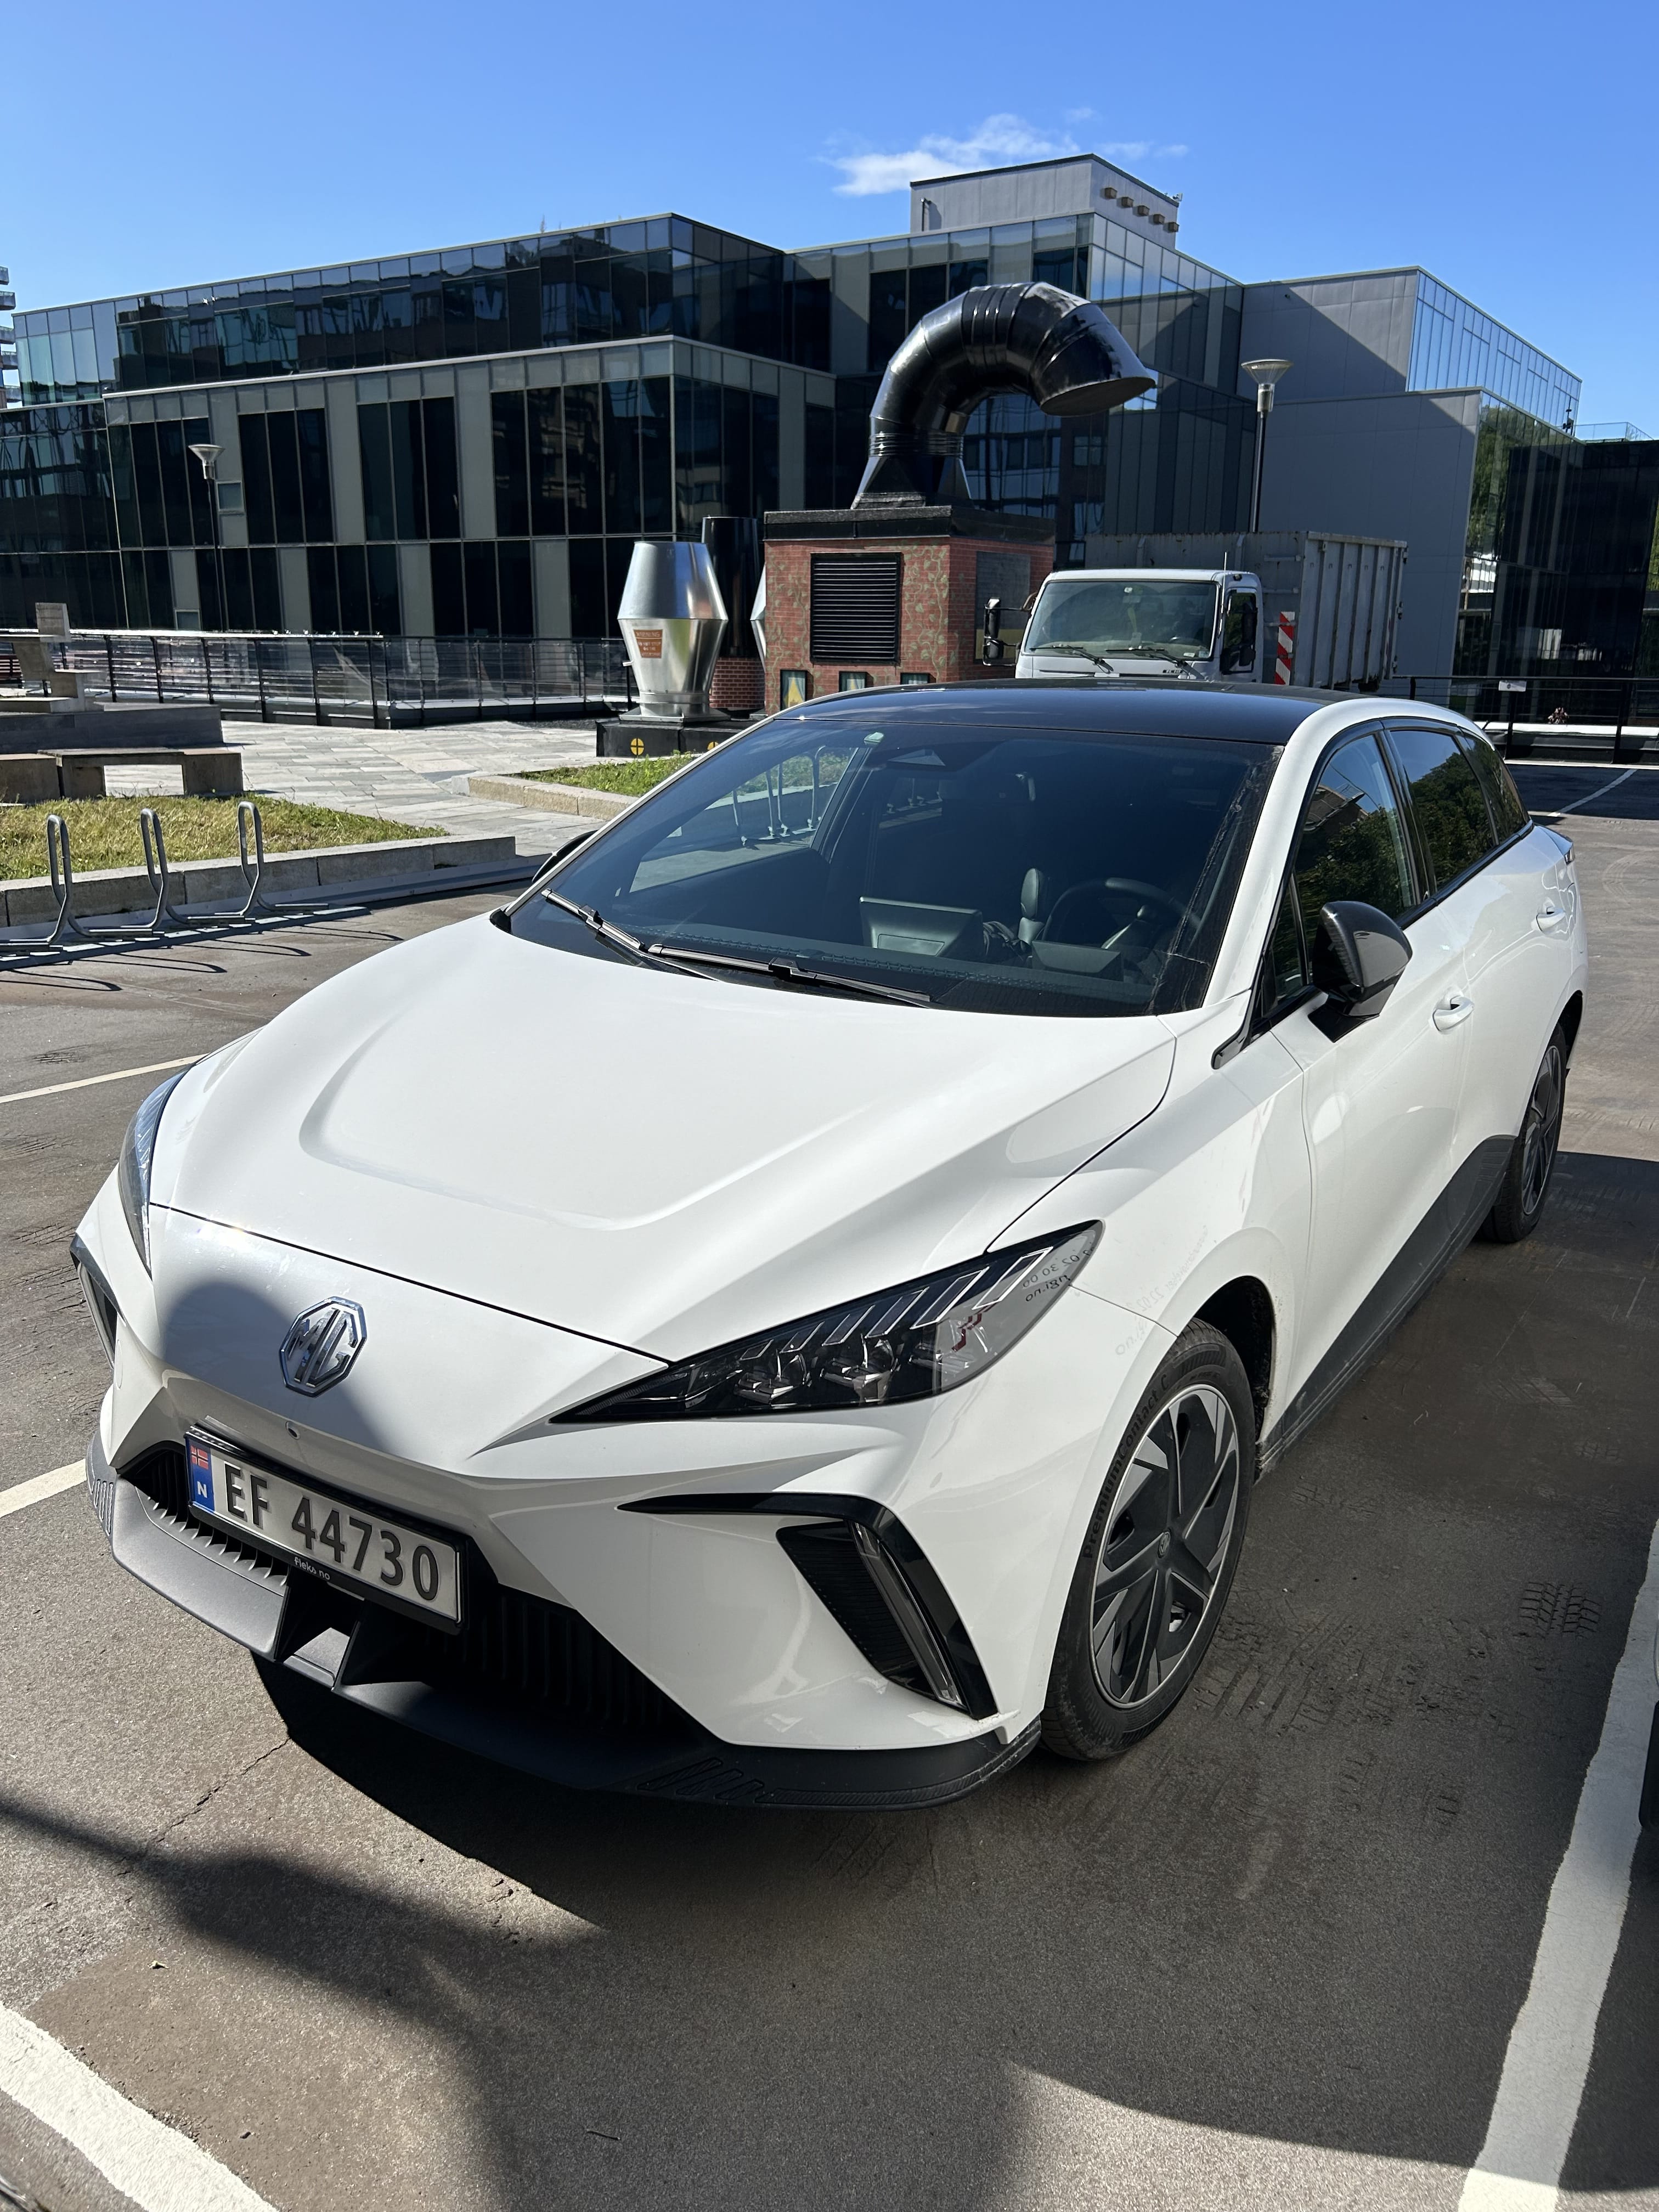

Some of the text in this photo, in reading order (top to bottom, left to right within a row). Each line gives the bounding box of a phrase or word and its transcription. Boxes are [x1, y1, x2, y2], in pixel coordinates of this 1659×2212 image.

[286, 1307, 359, 1388] MG
[197, 1481, 208, 1498] N
[224, 1461, 439, 1601] EF 44730
[294, 1556, 317, 1575] fleks
